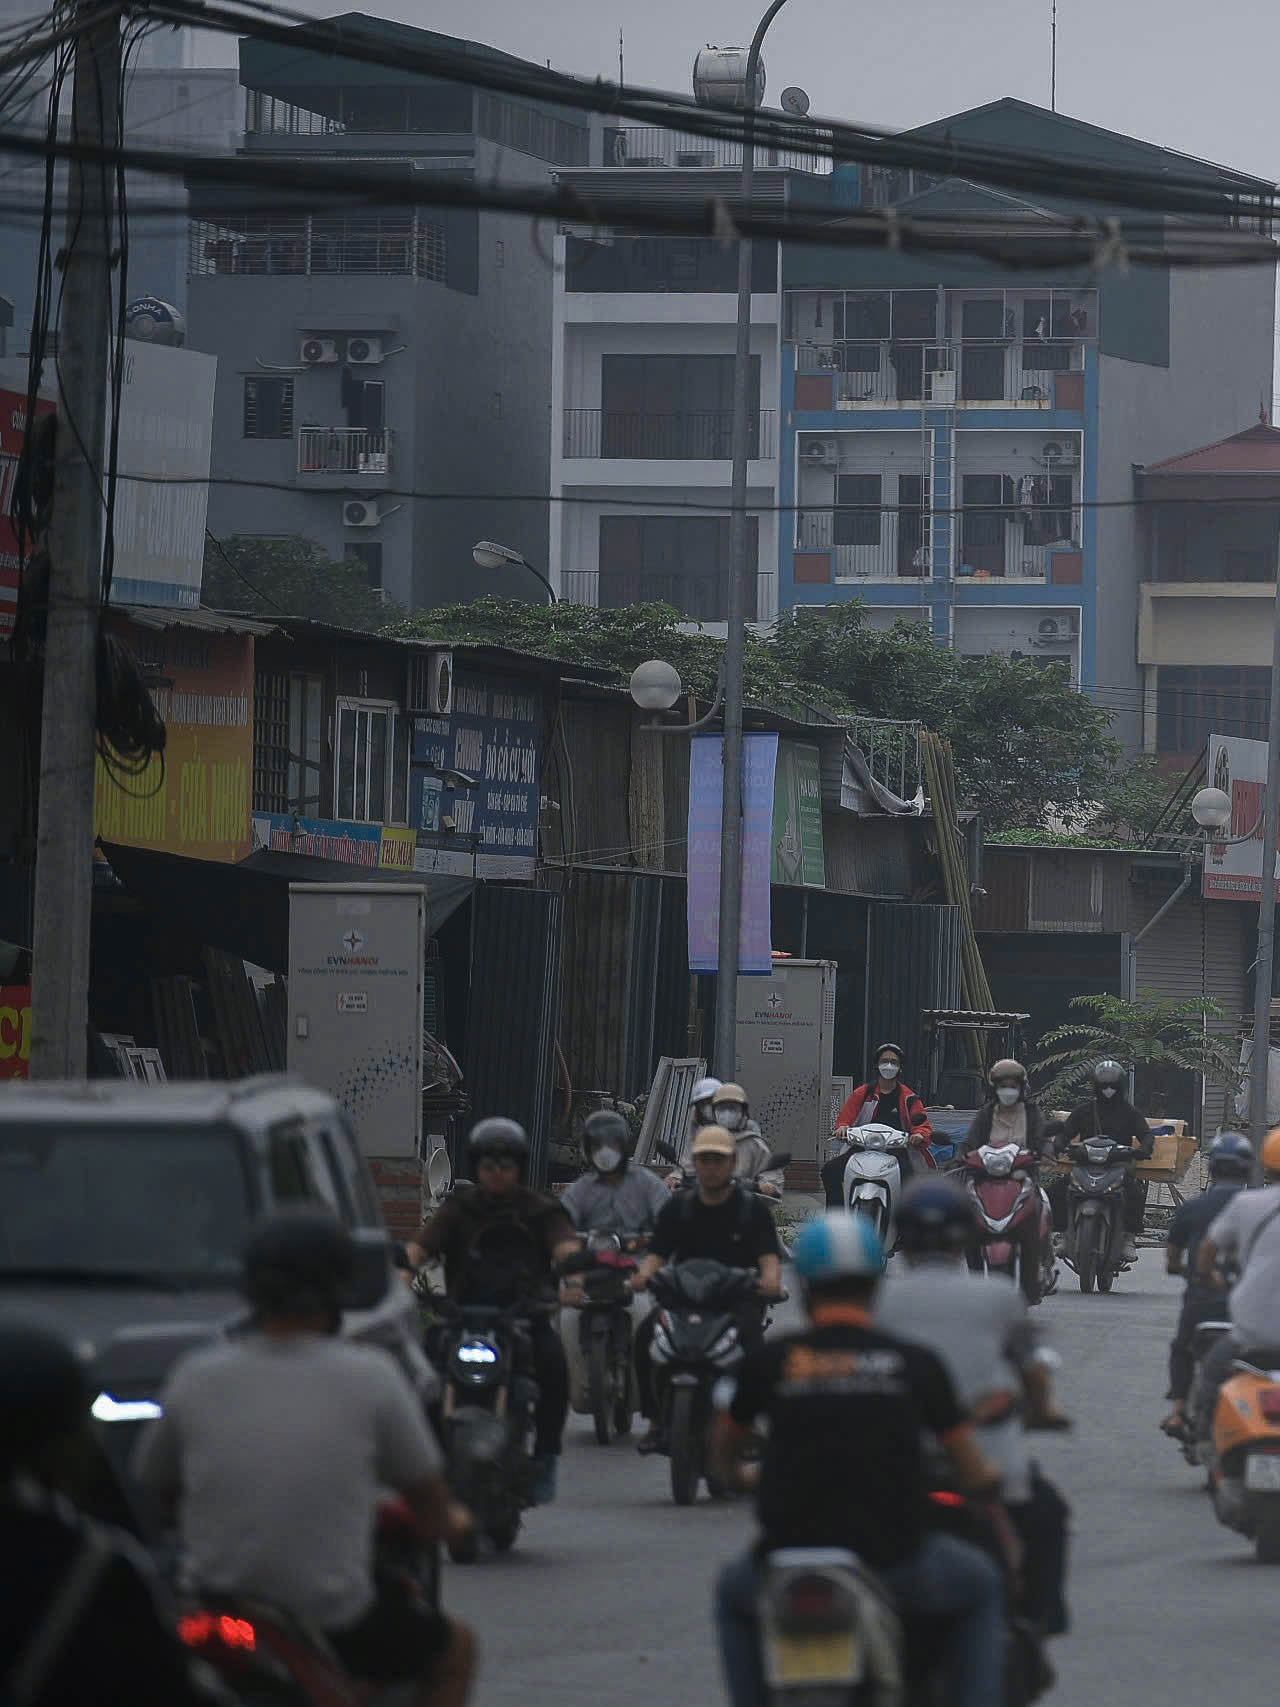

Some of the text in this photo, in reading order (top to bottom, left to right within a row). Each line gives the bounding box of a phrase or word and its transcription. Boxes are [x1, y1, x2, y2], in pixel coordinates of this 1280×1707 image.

[382, 838, 396, 865] THU
[397, 839, 413, 867] MUA
[327, 956, 379, 967] EVNHANOI
[754, 1011, 793, 1020] EVNHANOI
